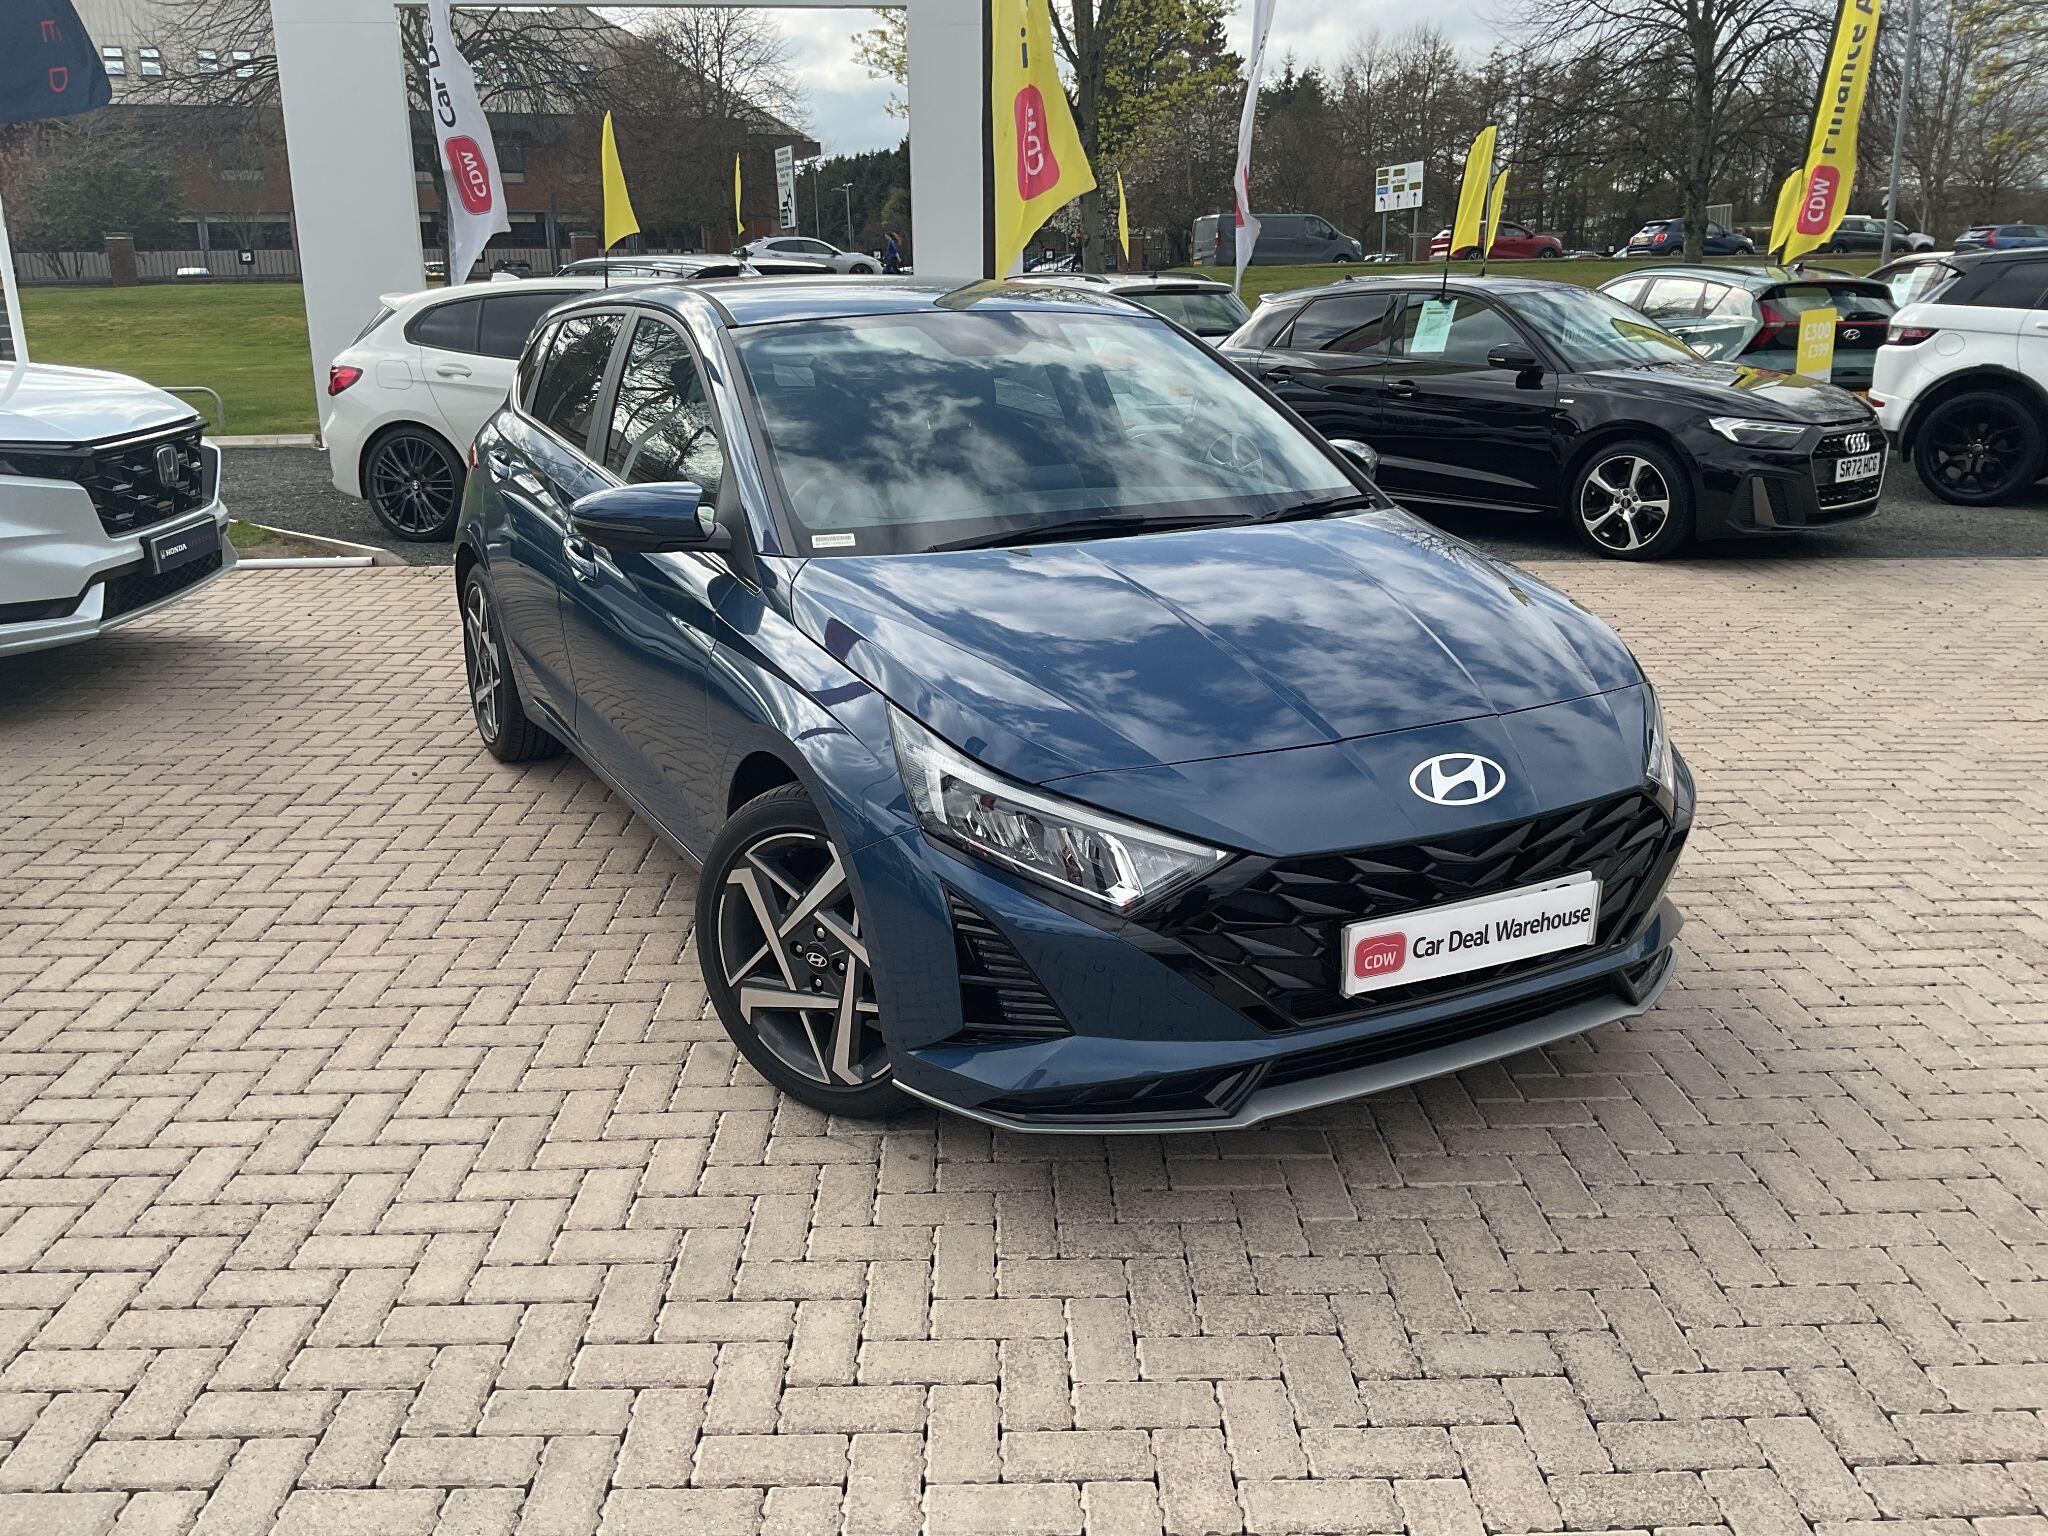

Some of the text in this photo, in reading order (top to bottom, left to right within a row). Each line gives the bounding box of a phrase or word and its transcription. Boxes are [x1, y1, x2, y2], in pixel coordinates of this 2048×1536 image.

[434, 77, 457, 128] Car
[461, 151, 487, 198] CDW
[1807, 177, 1831, 222] CDW
[1840, 458, 1863, 478] SR72
[165, 543, 188, 557] HONDA
[1364, 907, 1591, 970] CDW Car Deal Warehouse
